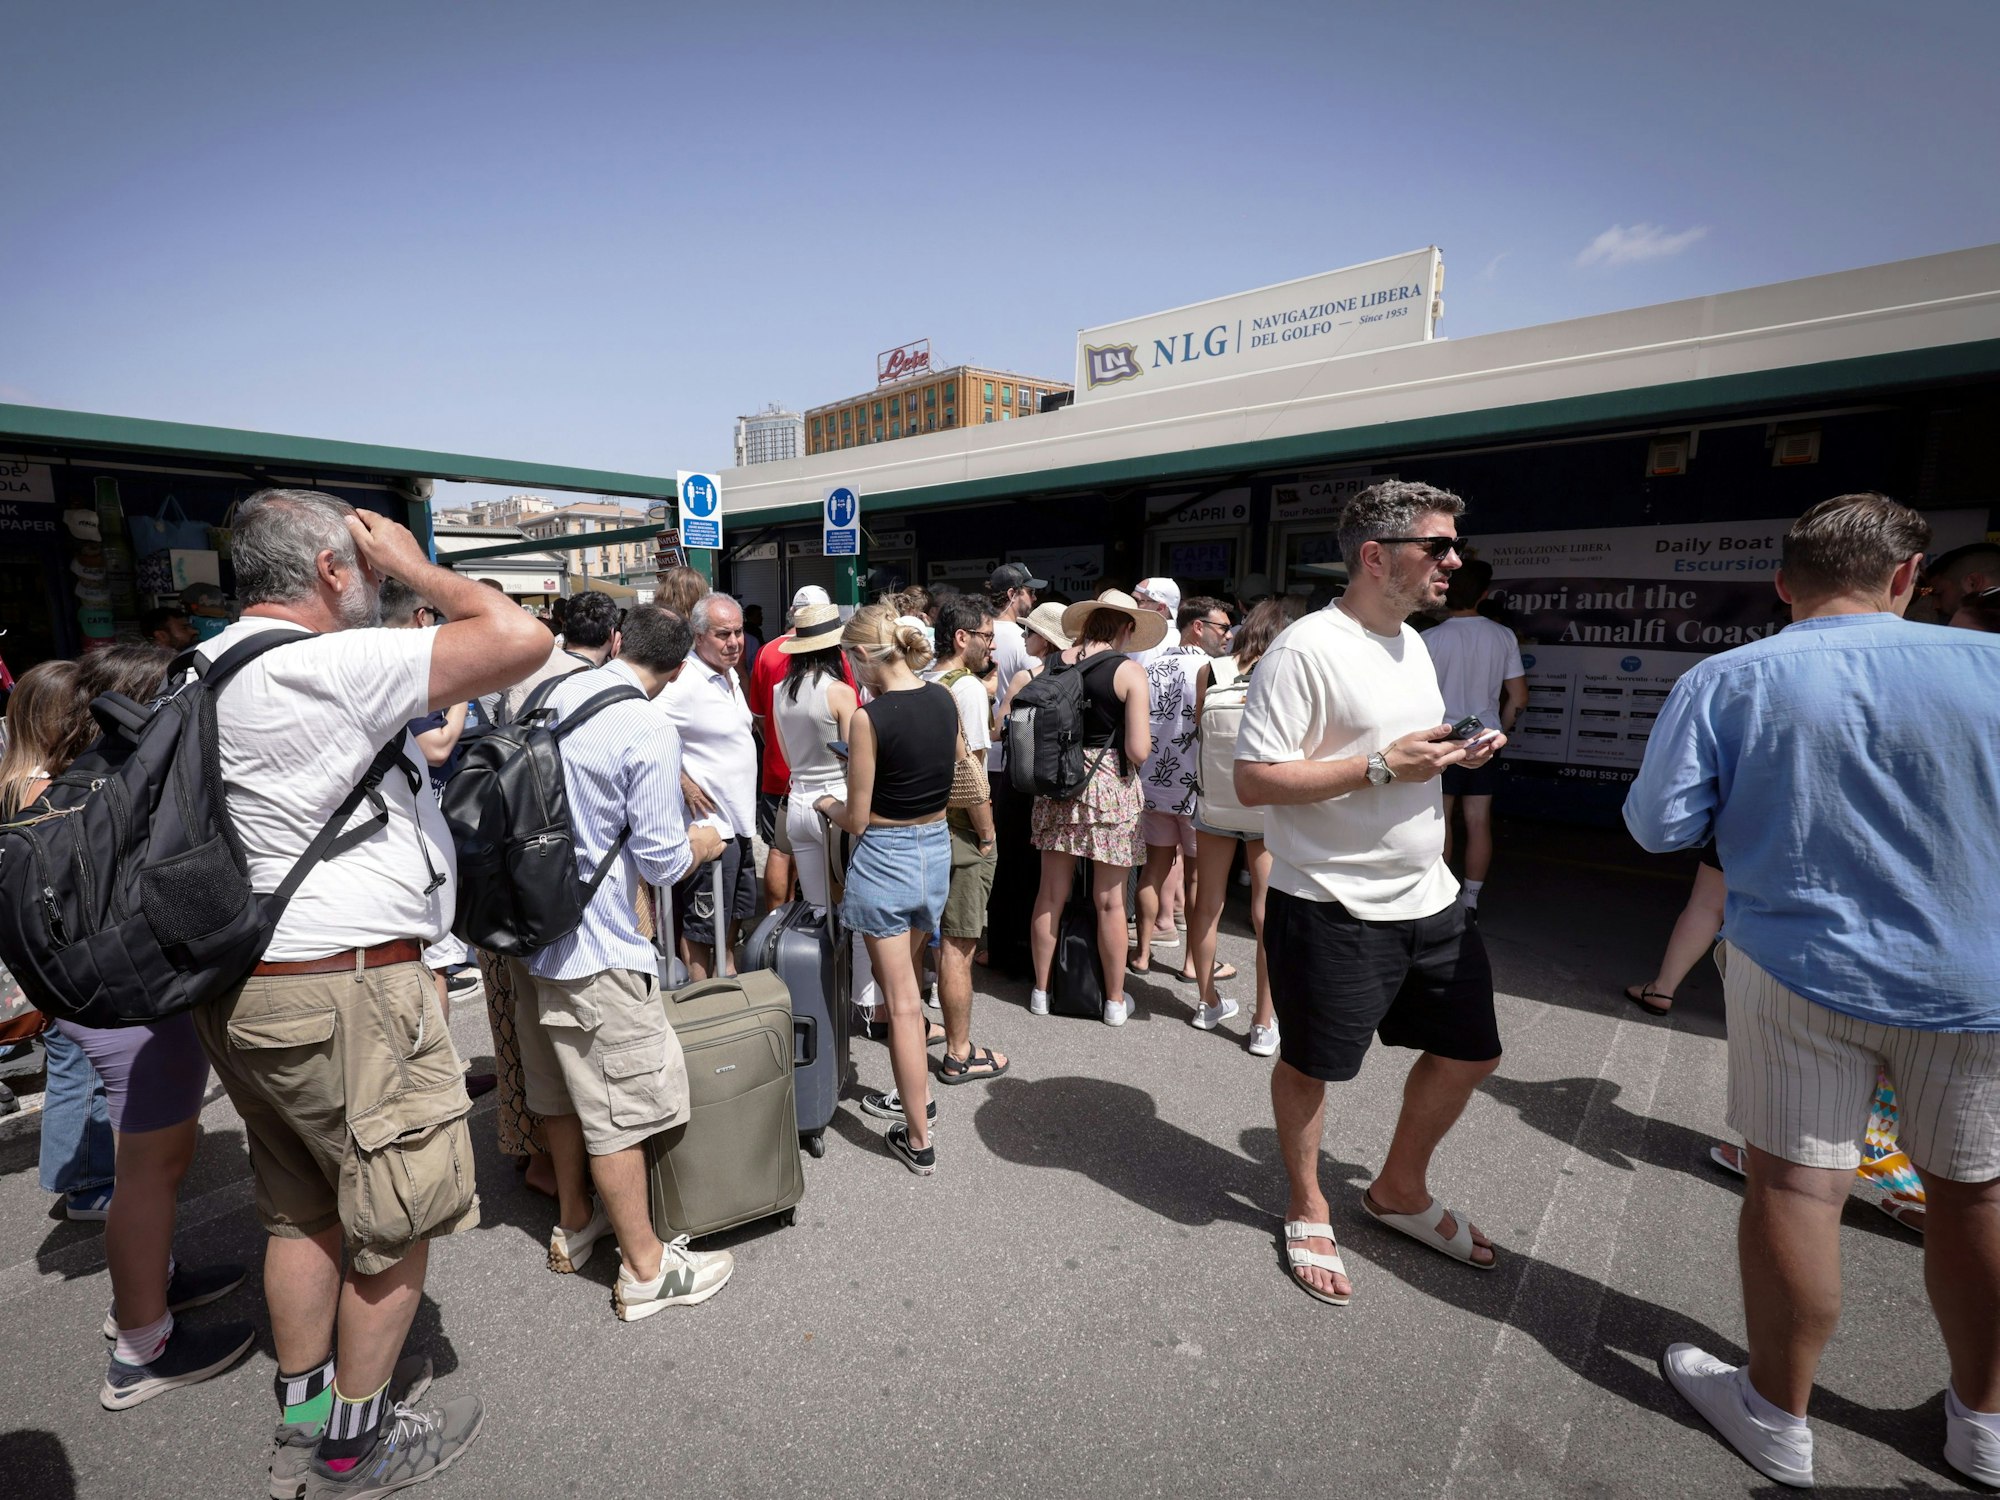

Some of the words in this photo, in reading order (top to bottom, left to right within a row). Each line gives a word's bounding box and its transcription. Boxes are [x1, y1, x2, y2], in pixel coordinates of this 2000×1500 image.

[1252, 297, 1357, 330] NAVIGAZIONE
[1361, 283, 1422, 308] LIBERA
[1251, 333, 1278, 348] DEL
[1282, 320, 1332, 341] GOLFO
[1359, 314, 1383, 325] Since
[1386, 307, 1408, 320] 1953
[1152, 325, 1227, 368] NLG
[880, 349, 928, 379] Lete
[1310, 481, 1364, 496] CAPRI
[1177, 506, 1226, 522] CAPRI
[1279, 509, 1299, 518] Tour
[658, 534, 679, 544] NAPLES
[1655, 538, 1712, 556] Daily
[1719, 536, 1774, 551] Boat
[1173, 544, 1227, 562] CAPRI
[1493, 544, 1568, 556] NAVIGAZIONE
[1570, 543, 1612, 553] LIBERA
[1492, 557, 1511, 566] DEL
[1514, 556, 1550, 566] GOLFO
[1575, 585, 1635, 610] and
[1645, 584, 1697, 609] the
[1559, 618, 1666, 644] Amalfi
[1676, 620, 1778, 644] Coast
[1557, 767, 1576, 777] +39
[1579, 769, 1597, 778] 081
[1599, 771, 1618, 780] 552
